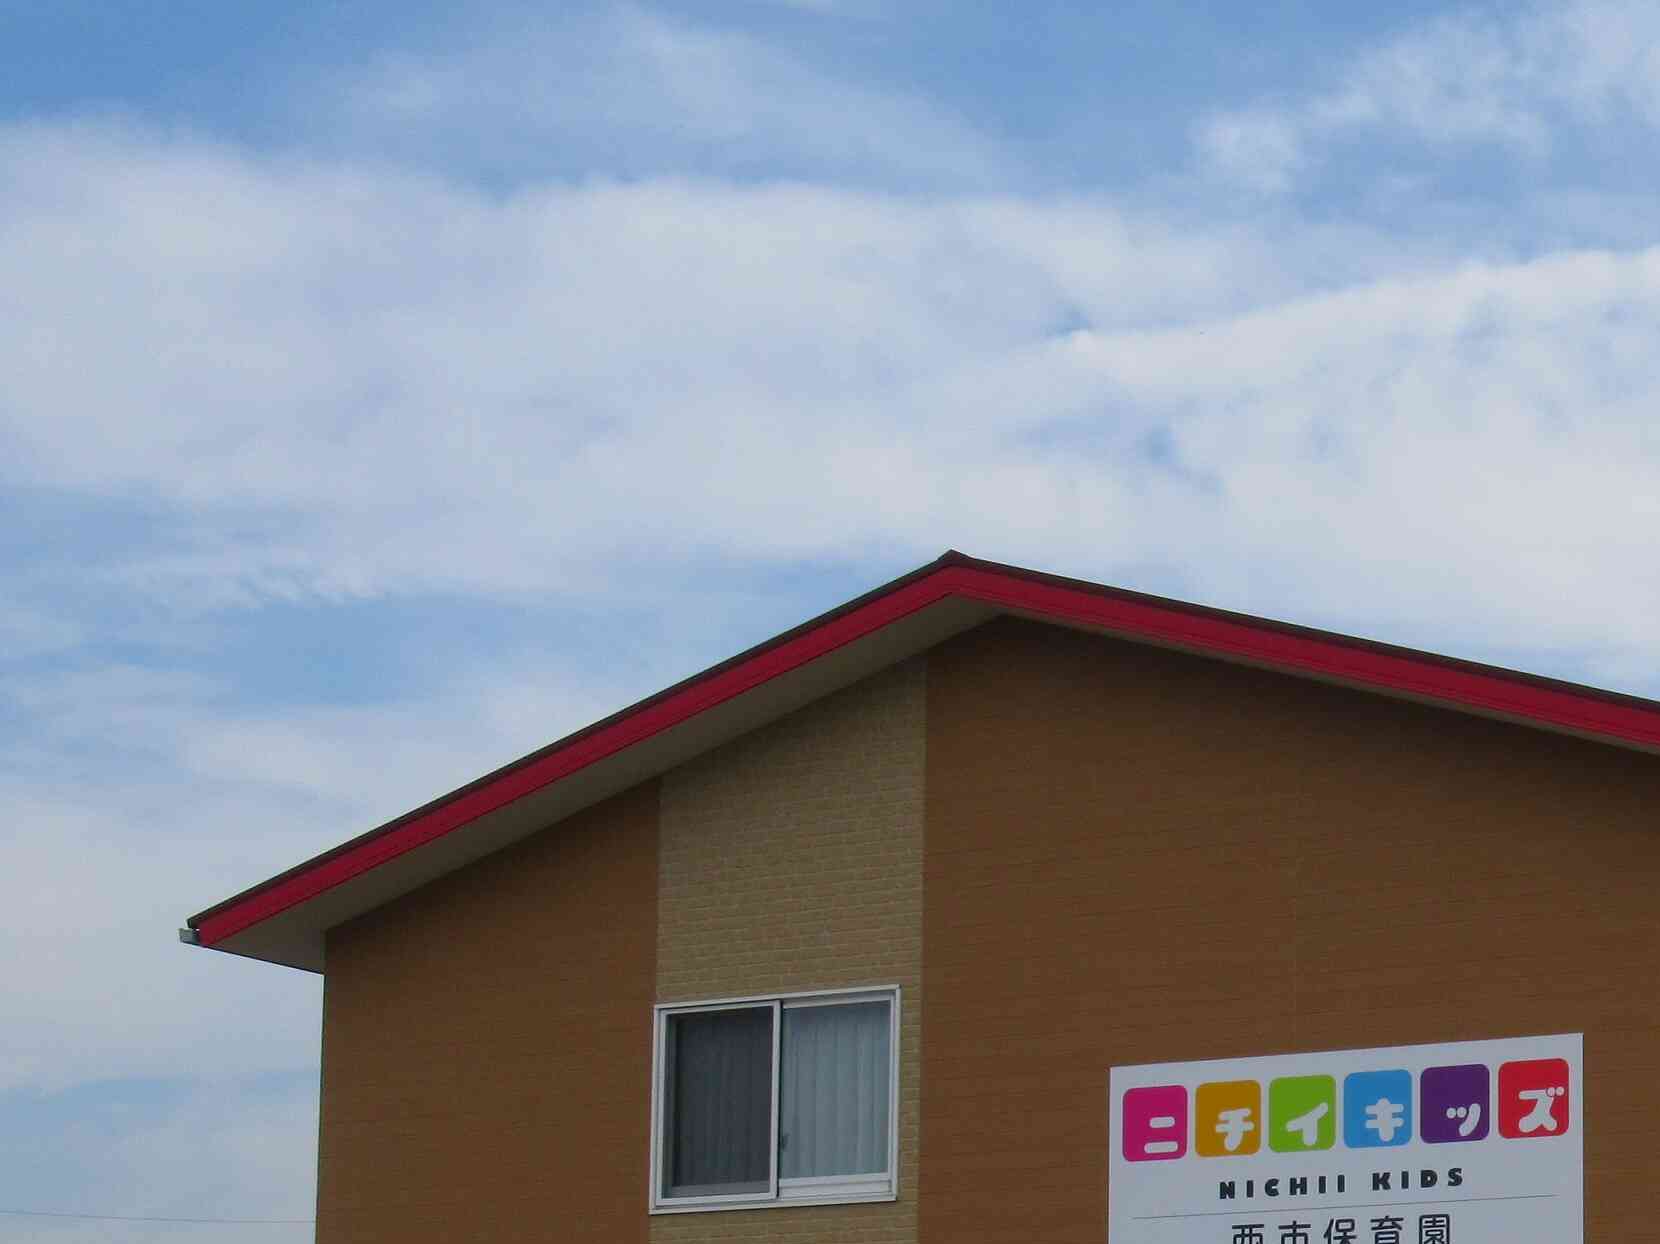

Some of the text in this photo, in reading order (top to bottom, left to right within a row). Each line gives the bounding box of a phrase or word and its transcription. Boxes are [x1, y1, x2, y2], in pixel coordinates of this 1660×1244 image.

[1142, 1085, 1566, 1154] ニチイキッズ
[1219, 1167, 1464, 1200] NICHII KIDS
